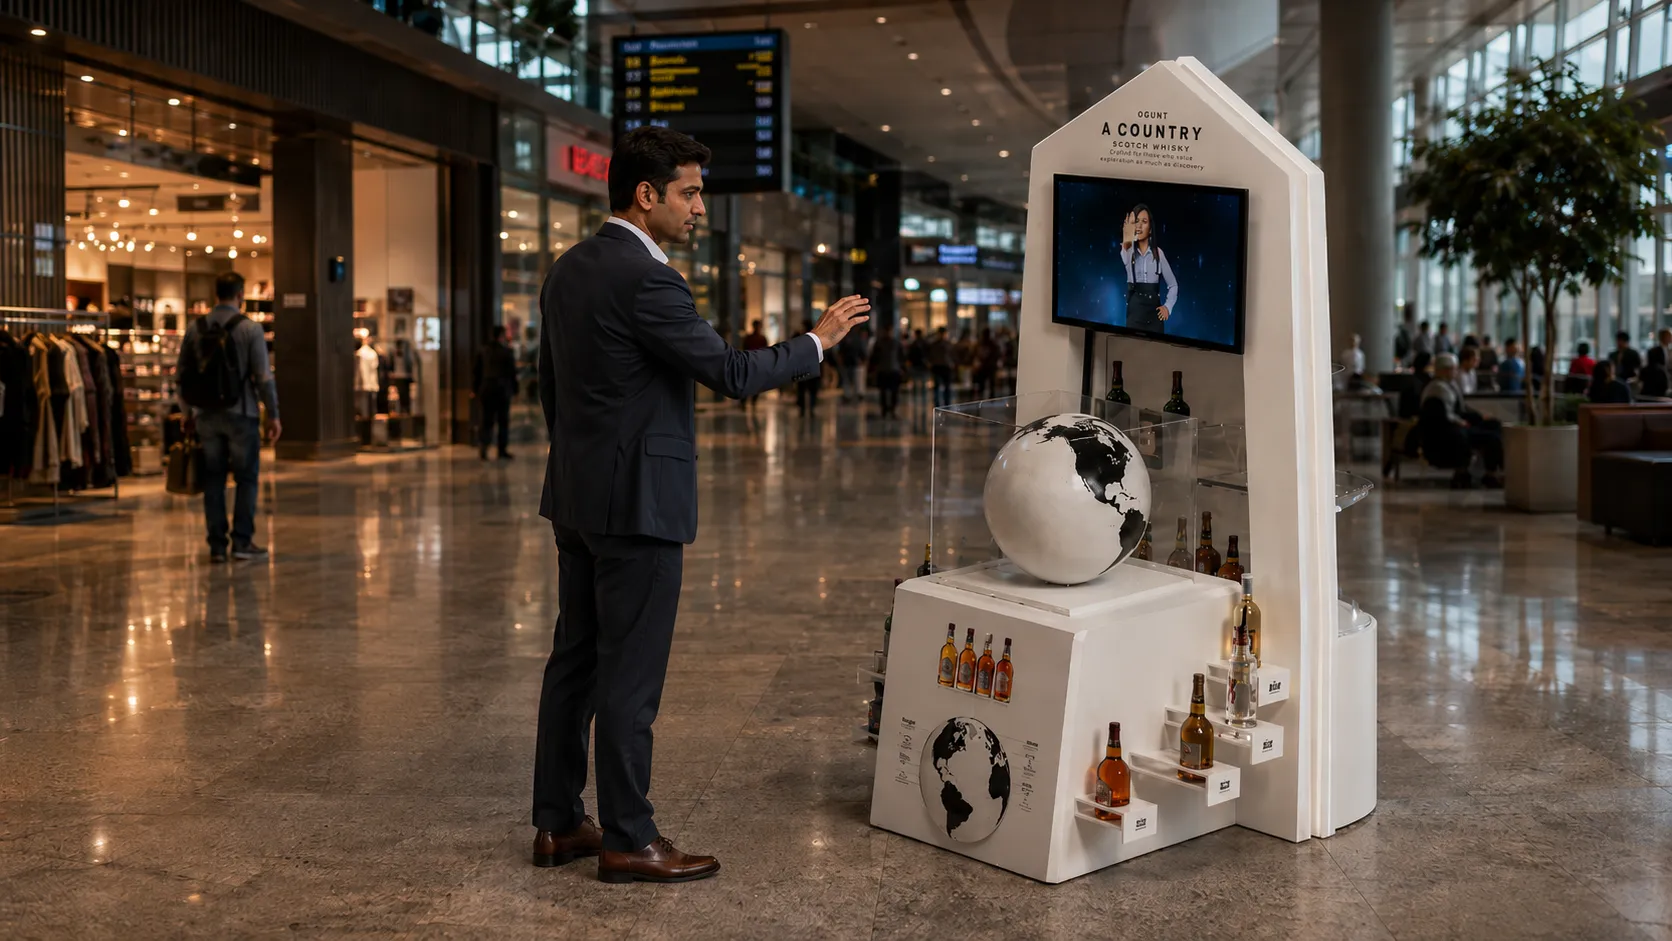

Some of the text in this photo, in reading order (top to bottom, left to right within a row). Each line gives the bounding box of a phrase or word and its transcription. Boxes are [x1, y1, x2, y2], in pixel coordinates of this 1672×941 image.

[1137, 111, 1168, 119] OGUNT
[1101, 122, 1202, 140] A COUNTRY
[1112, 141, 1190, 152] SCOTCH WHISKY
[1173, 162, 1204, 170] discovery
